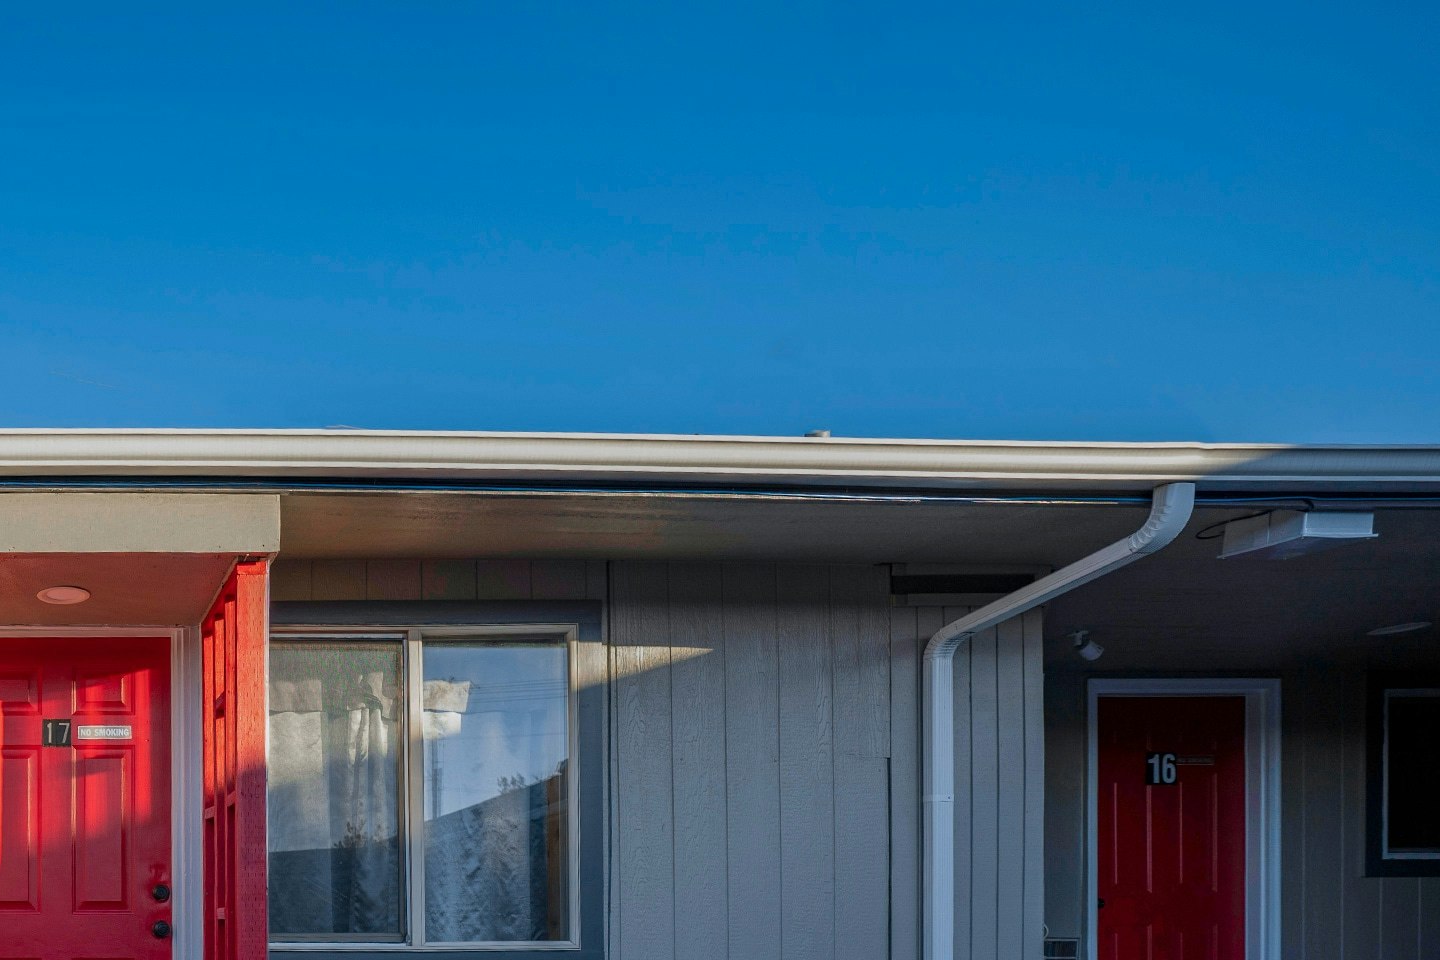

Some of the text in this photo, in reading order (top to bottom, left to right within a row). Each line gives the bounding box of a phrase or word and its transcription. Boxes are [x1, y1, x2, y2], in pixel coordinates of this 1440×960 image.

[46, 722, 70, 743] 17
[80, 728, 130, 737] NO SMOKING
[1147, 753, 1176, 784] 16
